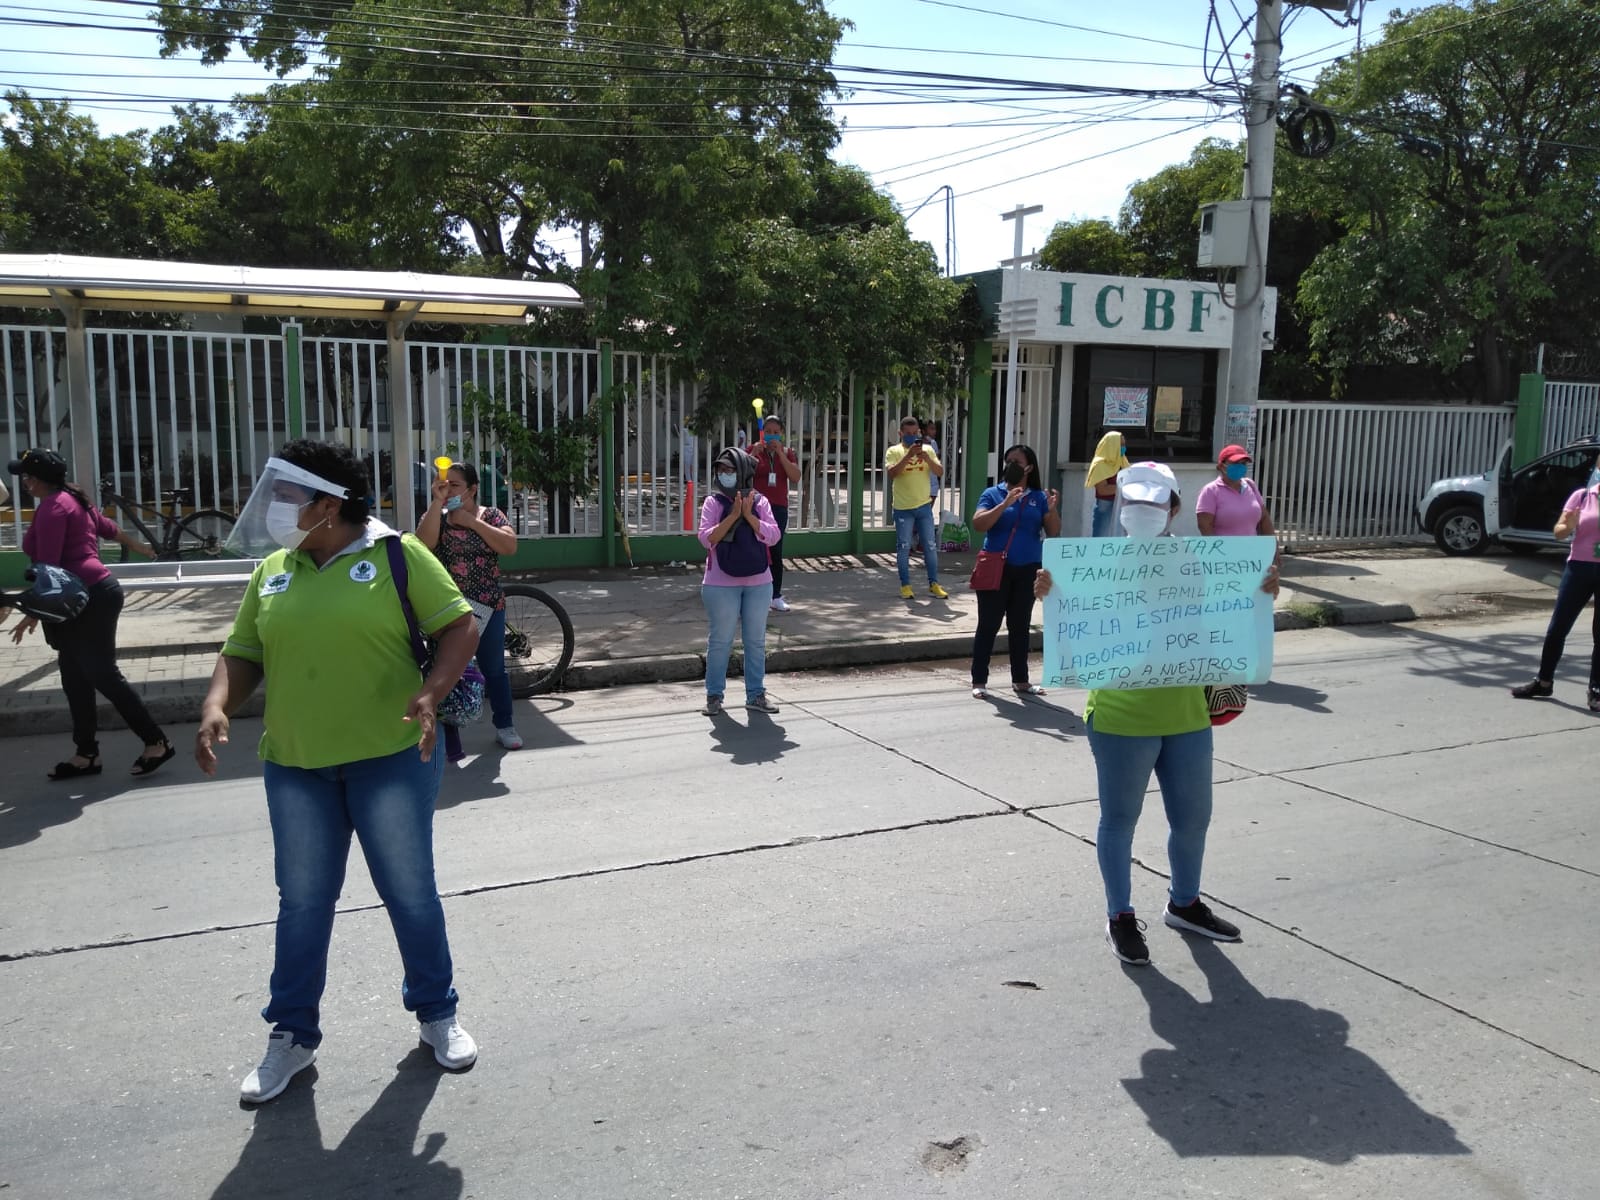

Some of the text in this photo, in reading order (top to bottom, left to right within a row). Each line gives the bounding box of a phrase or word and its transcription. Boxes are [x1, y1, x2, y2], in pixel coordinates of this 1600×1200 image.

[1061, 539, 1226, 559] EN BIENESTAR
[1072, 560, 1262, 582] FAMILIAR GENERAN
[1058, 580, 1242, 613] MALESTAR FAMILIAR
[1058, 597, 1255, 642] POR LA ESTABILIDAD
[1166, 632, 1200, 651] POR
[1210, 630, 1233, 644] EL
[1050, 656, 1248, 687] RESPETO A NUESTROS
[1118, 672, 1229, 689] DERECHOS
